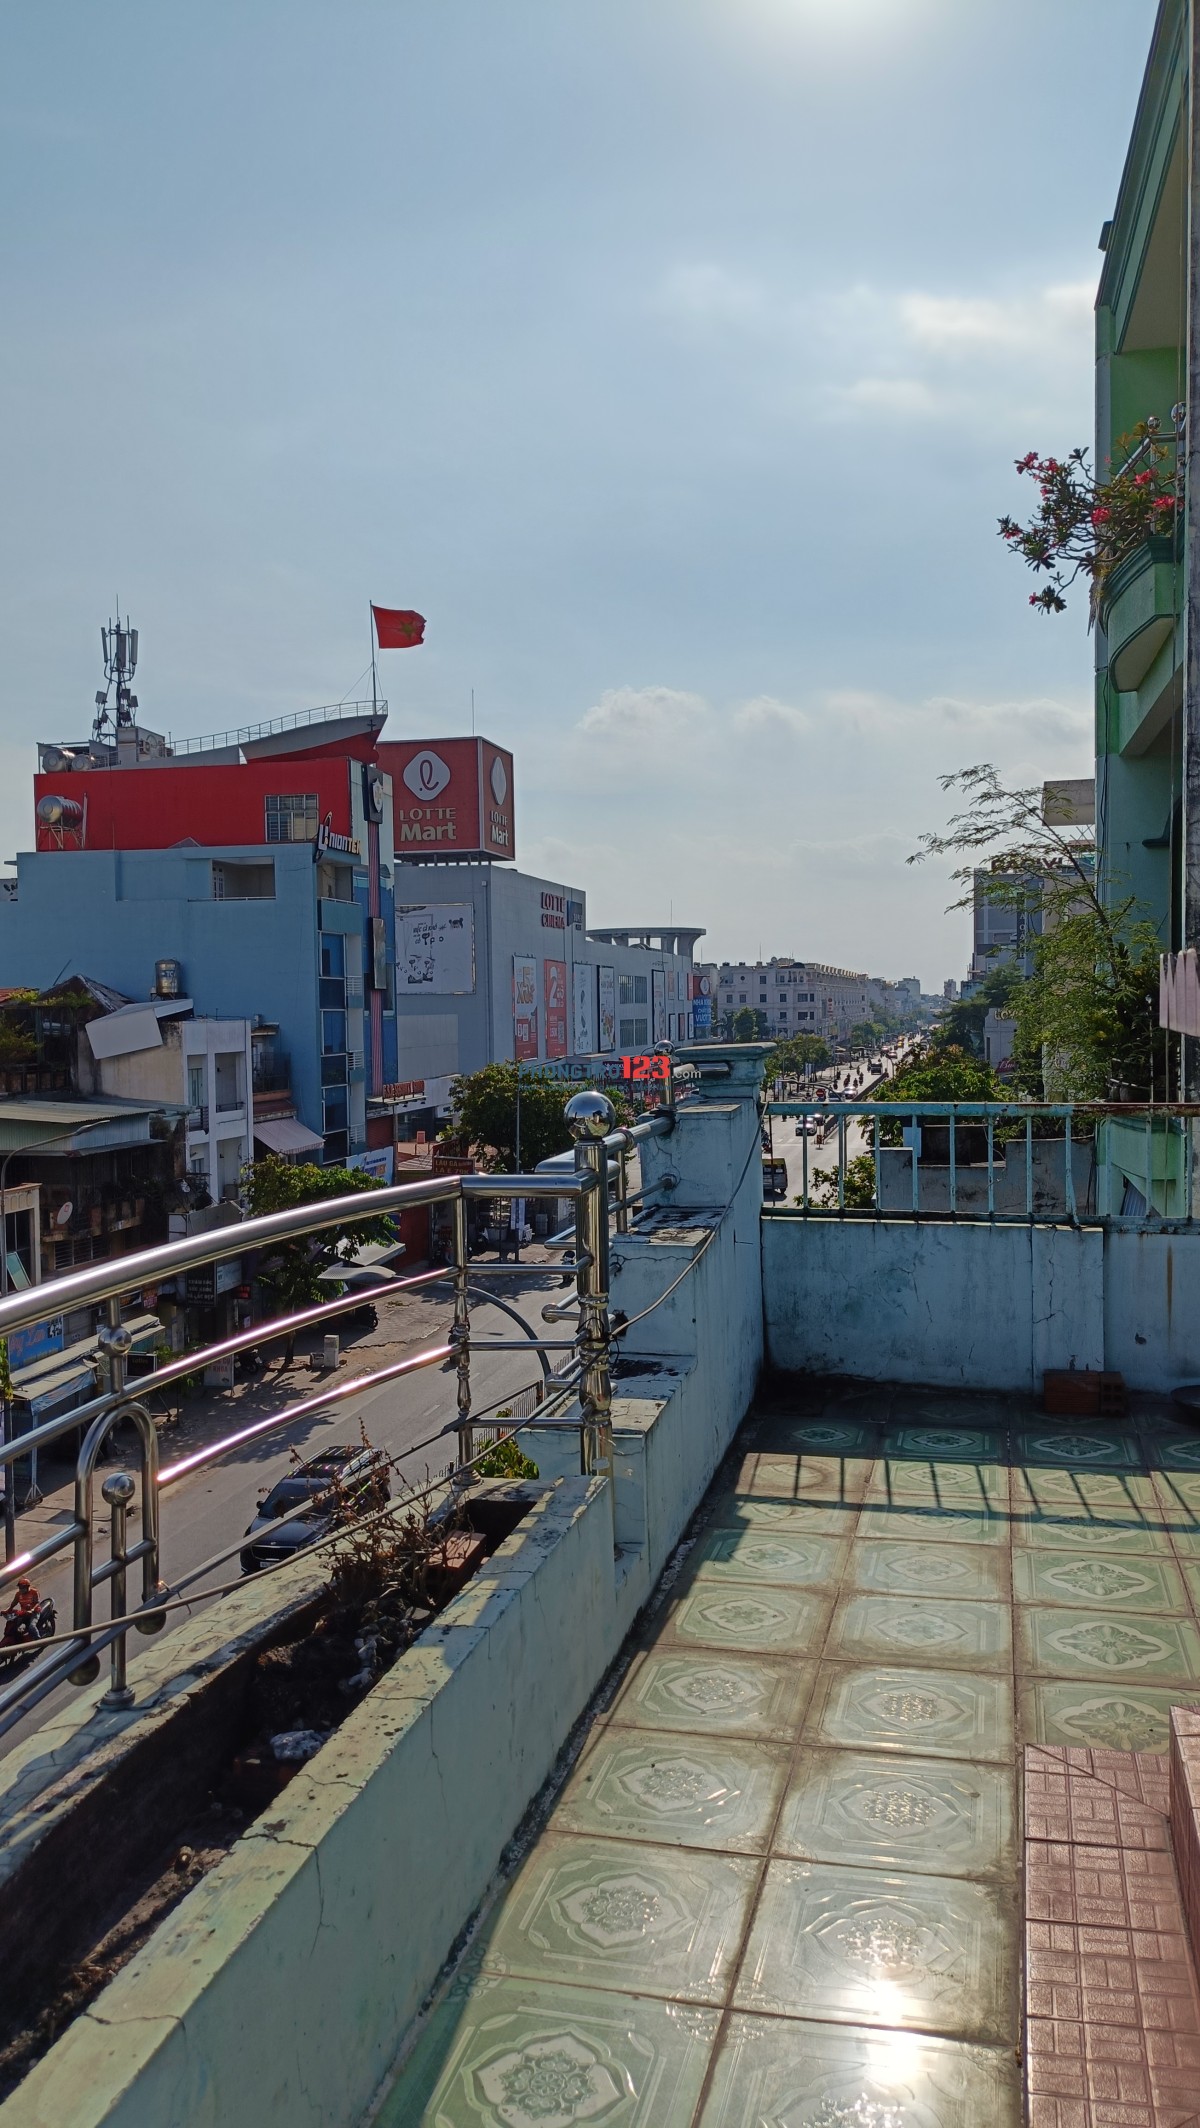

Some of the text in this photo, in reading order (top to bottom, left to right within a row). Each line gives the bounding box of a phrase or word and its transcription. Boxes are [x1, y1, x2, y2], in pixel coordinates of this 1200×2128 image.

[399, 807, 457, 821] LOTTE
[400, 821, 457, 842] Mart
[491, 825, 509, 847] Mart
[541, 891, 566, 913] LOTTE
[541, 913, 566, 930] CINEMA
